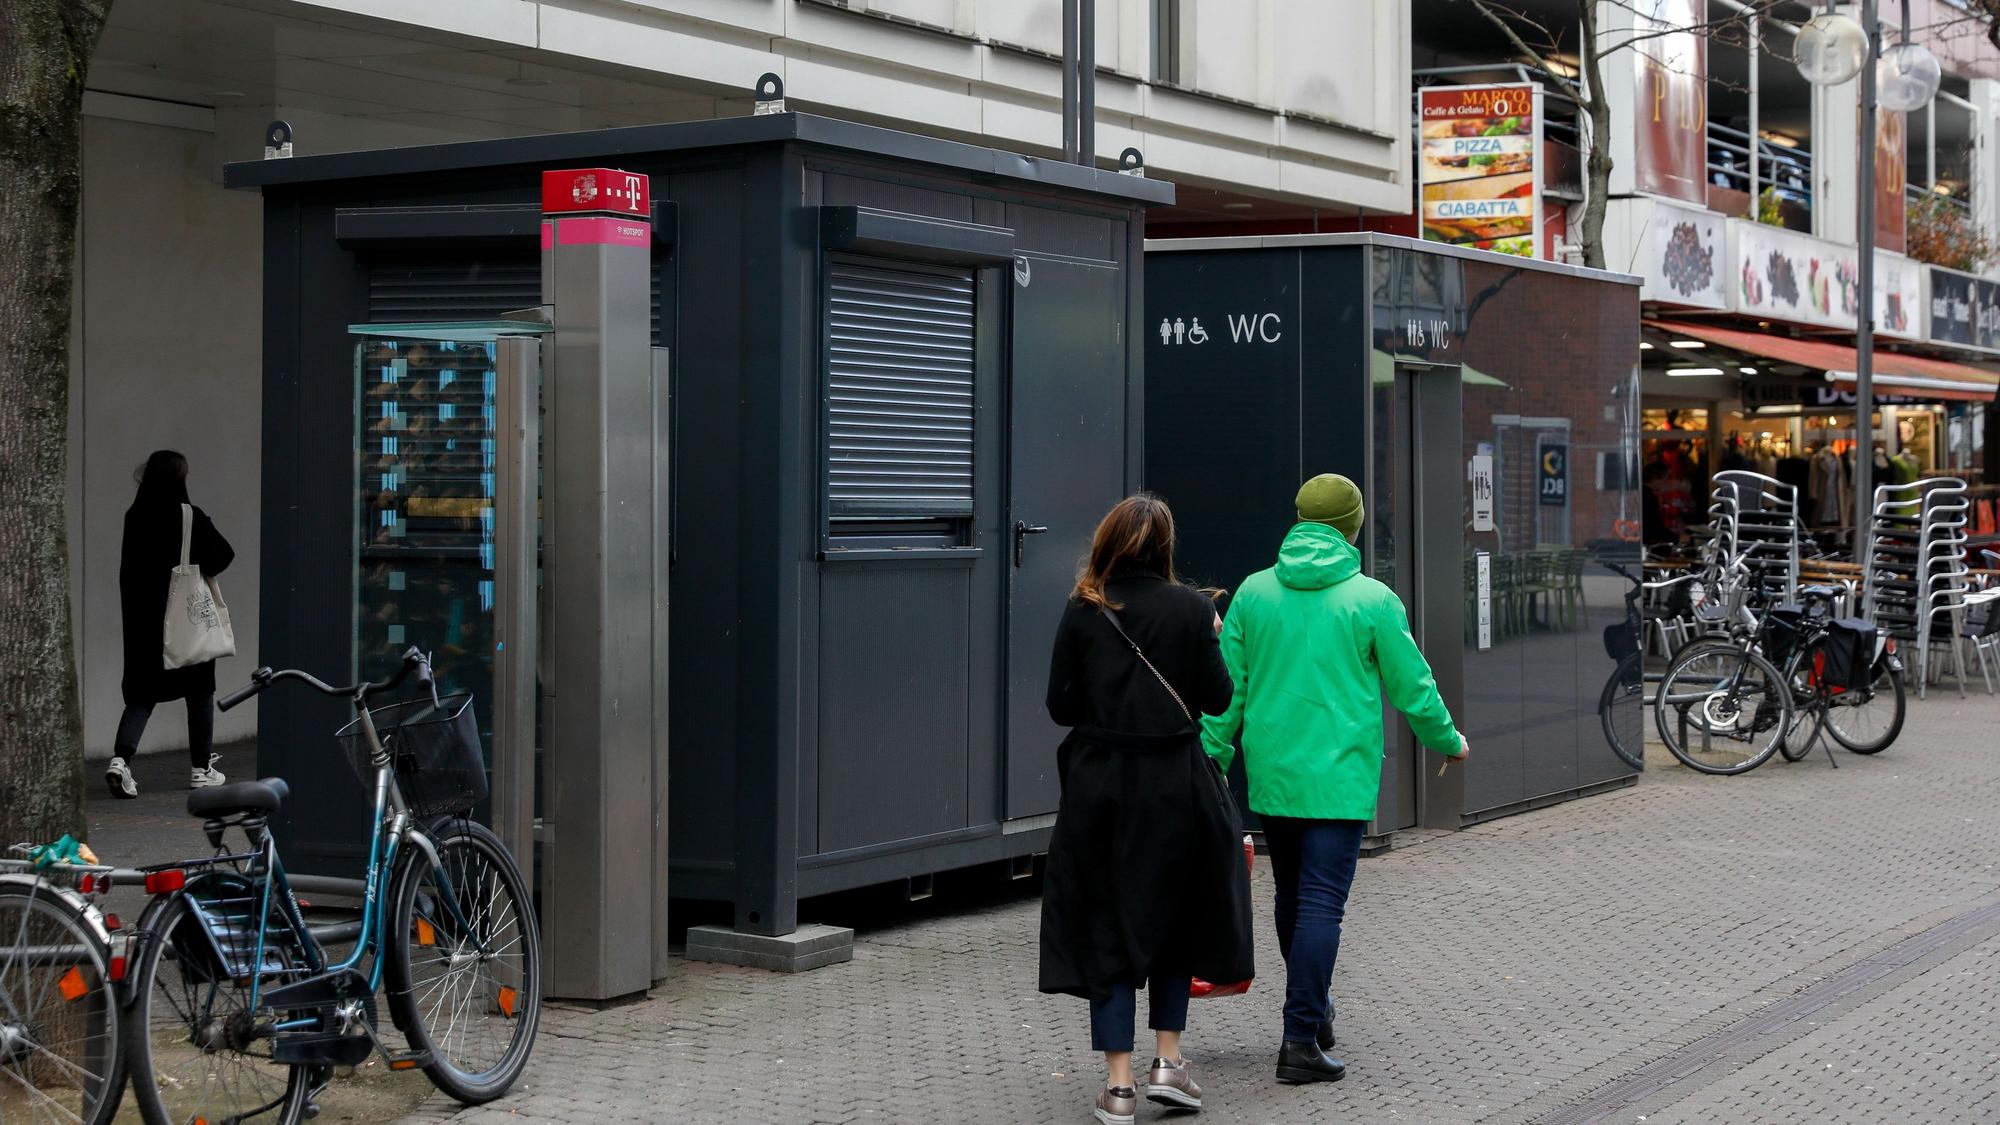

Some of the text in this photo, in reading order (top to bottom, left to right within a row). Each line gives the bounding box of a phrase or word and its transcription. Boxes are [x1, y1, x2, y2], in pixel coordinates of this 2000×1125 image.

[1462, 89, 1526, 105] MARCO
[1447, 107, 1456, 115] &
[1457, 105, 1484, 115] Gelato
[1485, 99, 1531, 116] POLO
[1455, 139, 1502, 153] PIZZA
[1438, 201, 1519, 216] CIABATTA
[1228, 313, 1281, 343] WC
[1431, 319, 1449, 349] WC
